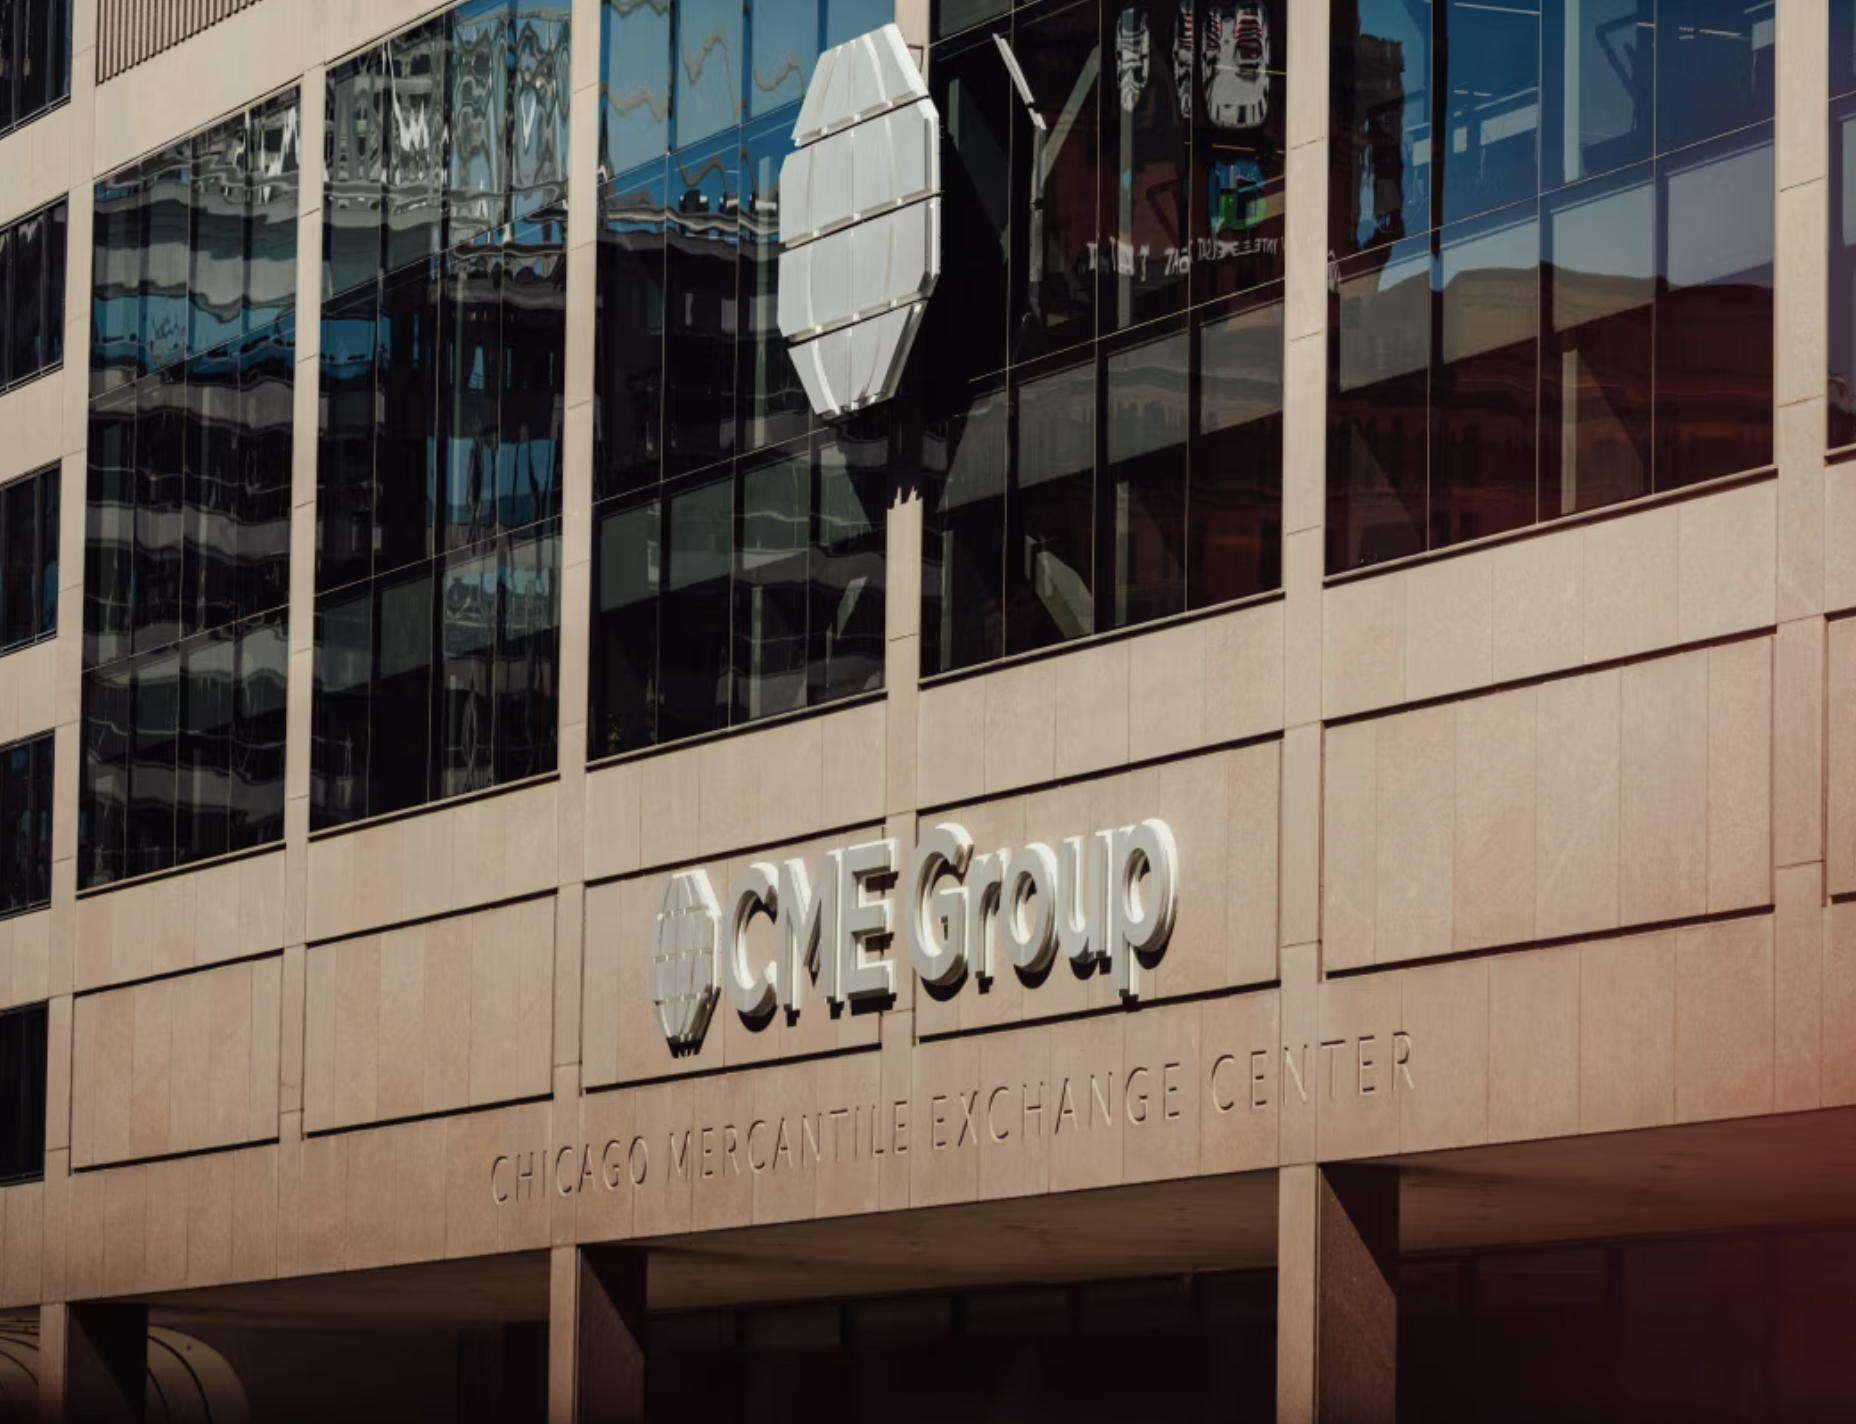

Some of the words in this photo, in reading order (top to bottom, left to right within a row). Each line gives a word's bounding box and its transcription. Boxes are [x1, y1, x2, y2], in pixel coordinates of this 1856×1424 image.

[723, 838, 899, 1019] CME
[908, 818, 1179, 999] Group
[491, 1135, 648, 1205] CHICAGO
[667, 1101, 908, 1183] MERCANTILE
[931, 1062, 1181, 1150] EXCHANGE
[1211, 1030, 1415, 1114] CENTER
